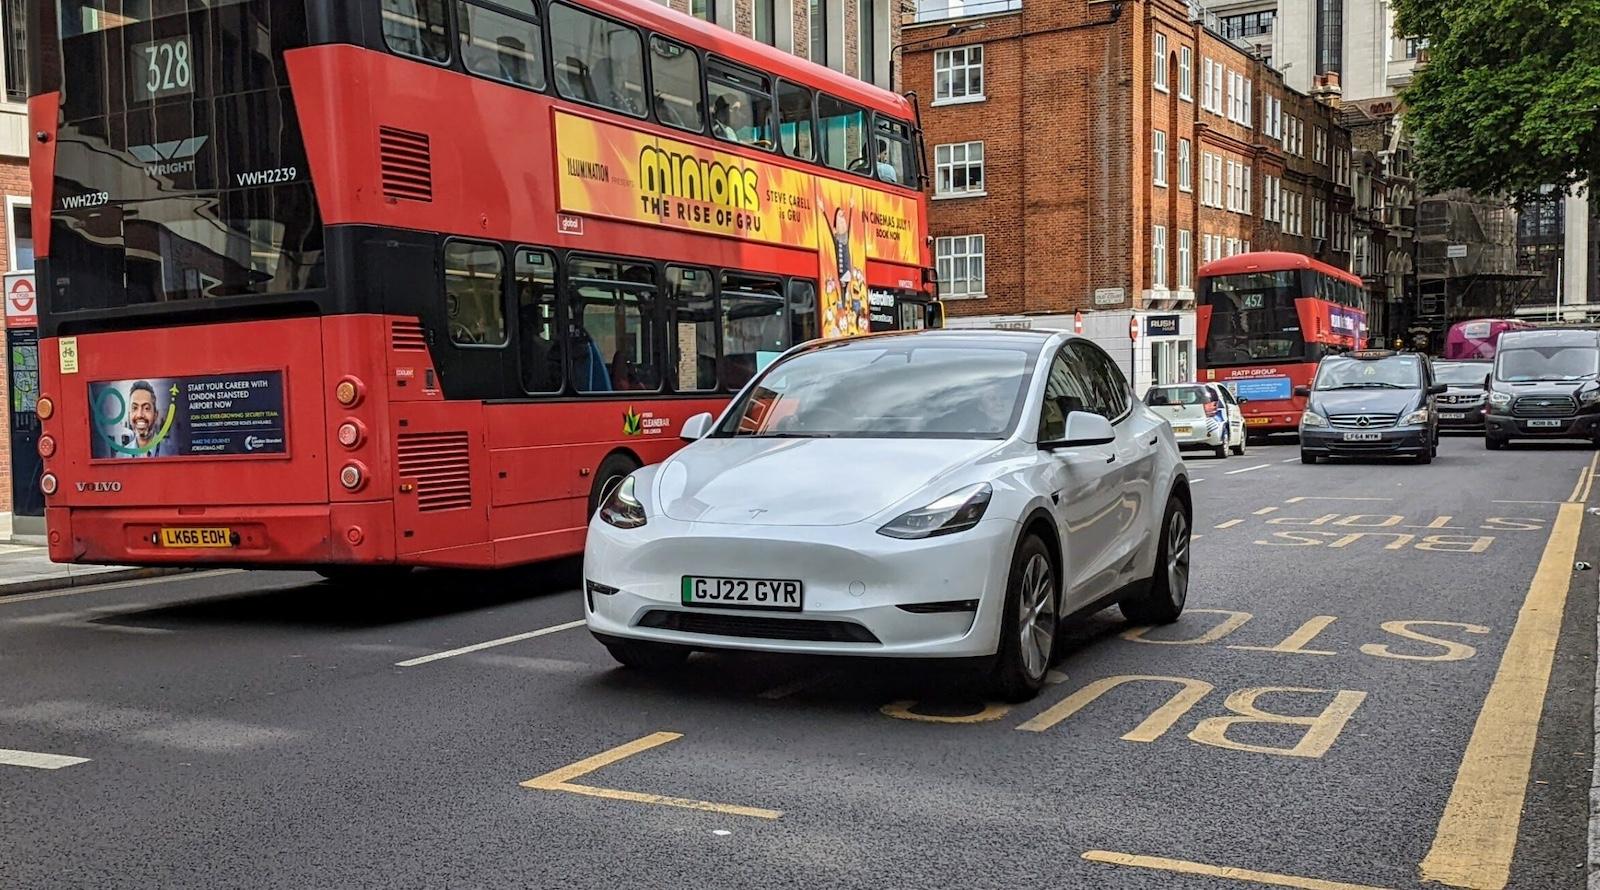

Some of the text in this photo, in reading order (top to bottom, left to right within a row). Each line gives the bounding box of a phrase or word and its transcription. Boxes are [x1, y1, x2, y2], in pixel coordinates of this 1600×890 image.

[145, 41, 190, 92] 328
[143, 161, 195, 176] WRIGHT
[236, 167, 297, 186] VWH2239
[567, 157, 609, 183] ILLUMINATION
[62, 191, 109, 210] VWH2239
[766, 190, 811, 210] STEVE CARELL
[640, 195, 761, 232] THE RISE OF GRU
[779, 209, 801, 223] is GRU
[861, 210, 869, 223] IN
[869, 212, 895, 228] CINEMAS
[896, 217, 907, 230] JULY
[876, 228, 900, 241] BOOK NOW
[1245, 294, 1262, 307] 452
[1150, 319, 1175, 328] RUSH
[187, 380, 268, 392] START YOUR CAREER WITH
[188, 391, 249, 401] LONDON STANSTED
[188, 402, 213, 410] AIRPORT
[1265, 513, 1546, 531] STOP
[167, 529, 226, 544] LK66 EOH
[1253, 531, 1496, 553] BUS
[695, 579, 797, 603] GJ22 GYR
